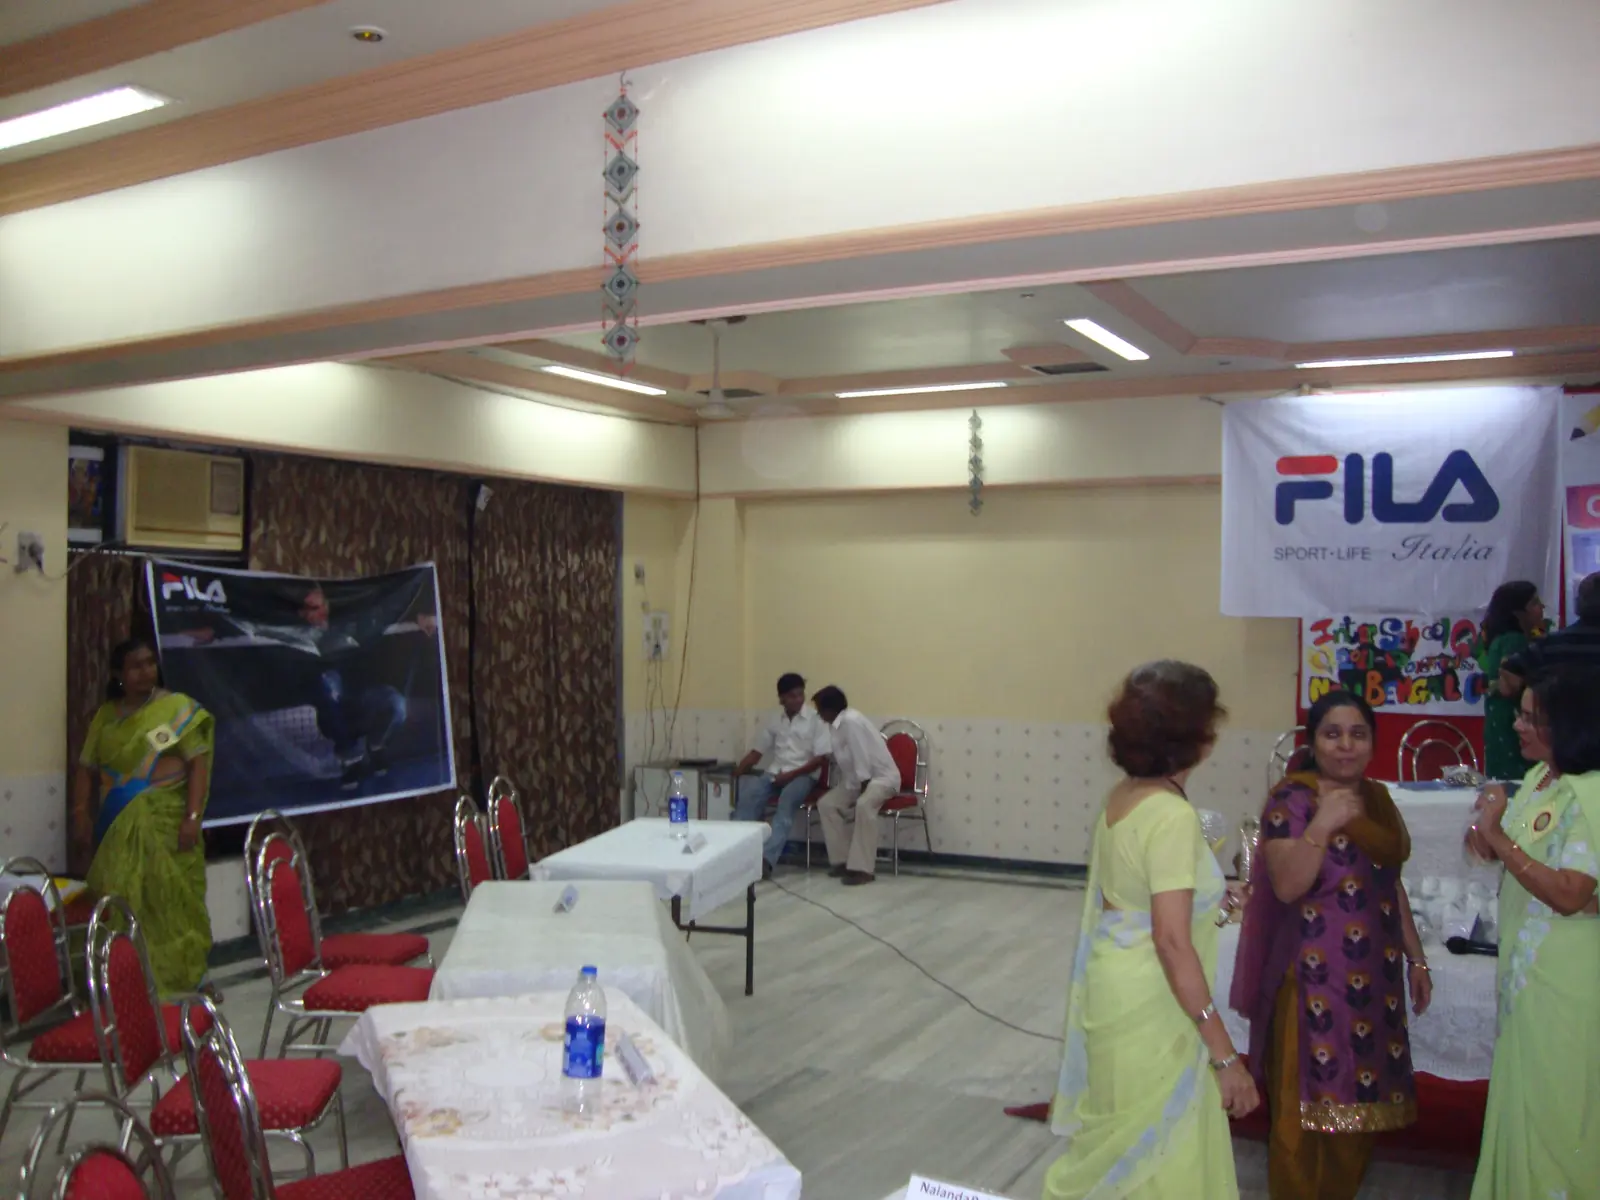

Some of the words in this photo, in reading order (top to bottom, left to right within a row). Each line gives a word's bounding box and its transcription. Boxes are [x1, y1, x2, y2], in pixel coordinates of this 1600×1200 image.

[1275, 448, 1500, 525] FILA
[1392, 534, 1496, 561] Italia
[161, 572, 227, 604] FILA
